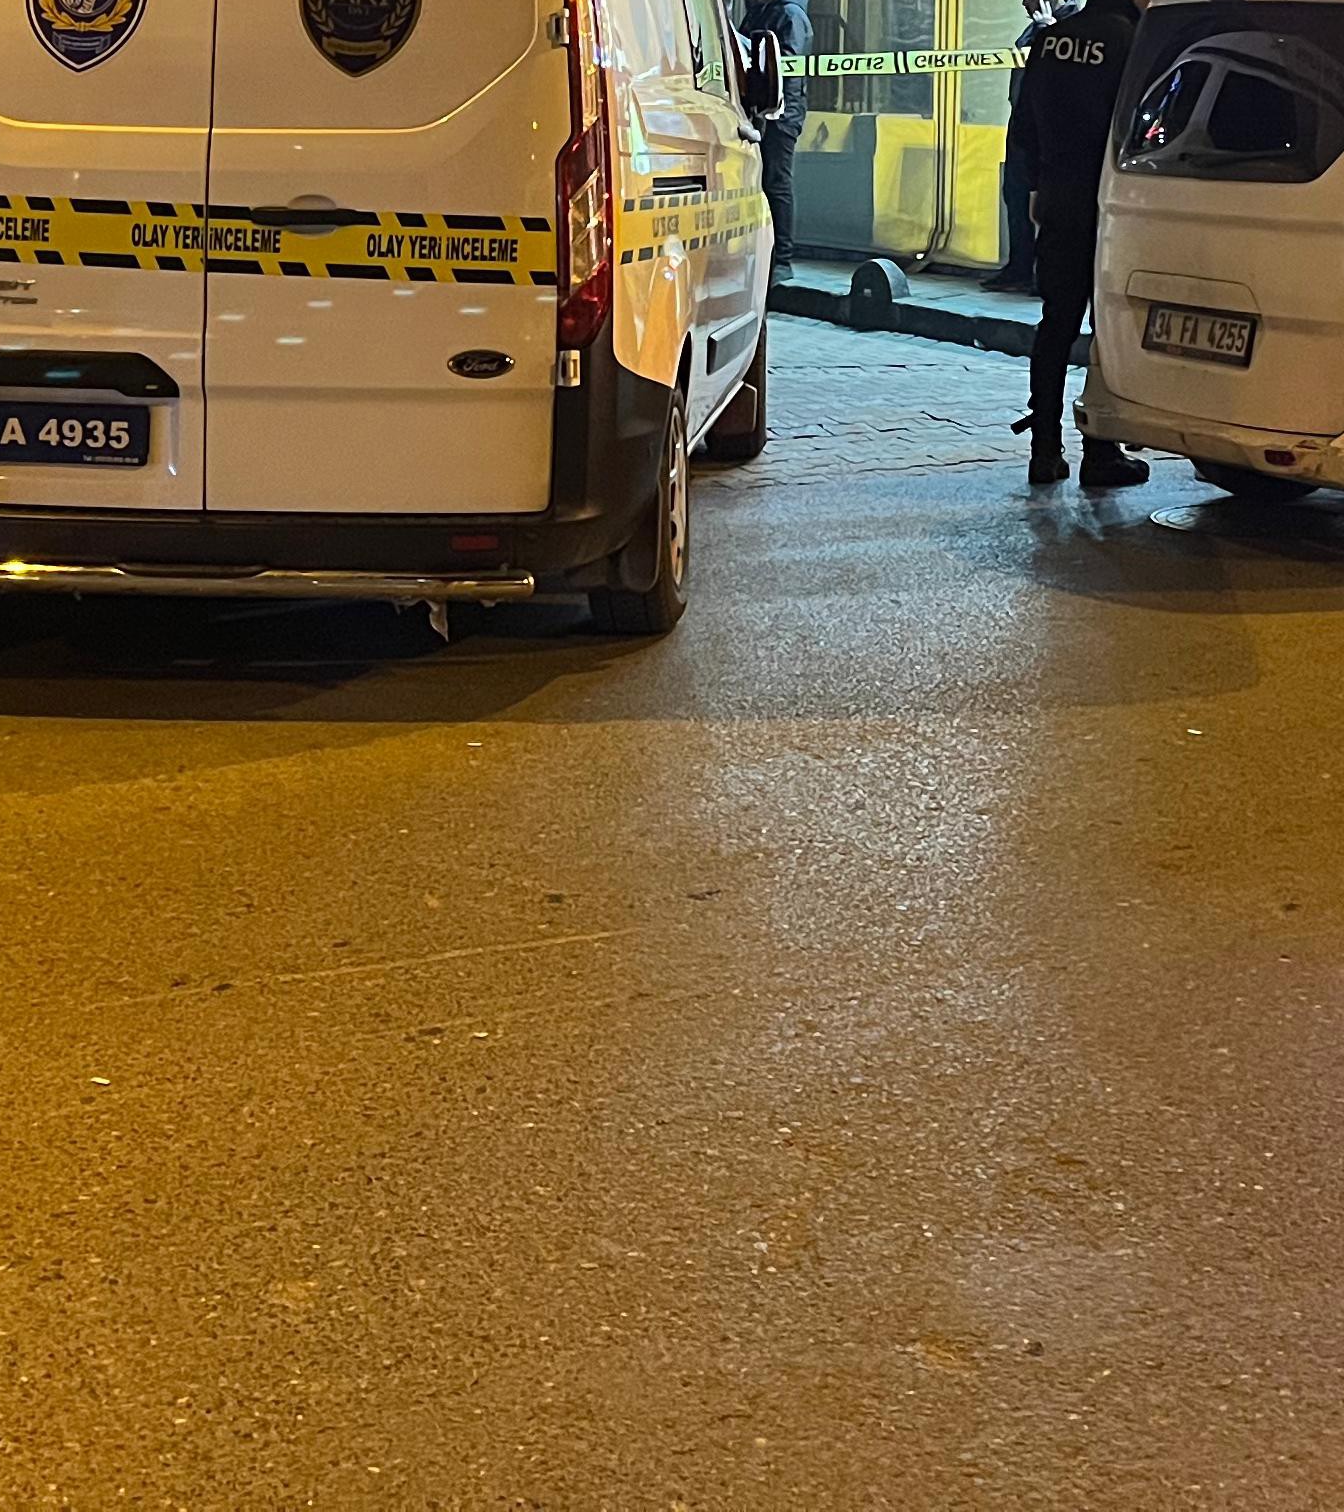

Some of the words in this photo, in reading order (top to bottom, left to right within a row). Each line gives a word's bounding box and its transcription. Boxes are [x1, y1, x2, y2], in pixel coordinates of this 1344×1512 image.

[131, 223, 167, 248] OLAY
[366, 233, 404, 258] OLAY
[1155, 312, 1173, 341] 34
[1180, 315, 1199, 345] FA
[1207, 319, 1249, 353] 4255
[0, 417, 27, 445] A
[38, 418, 130, 449] 4935
